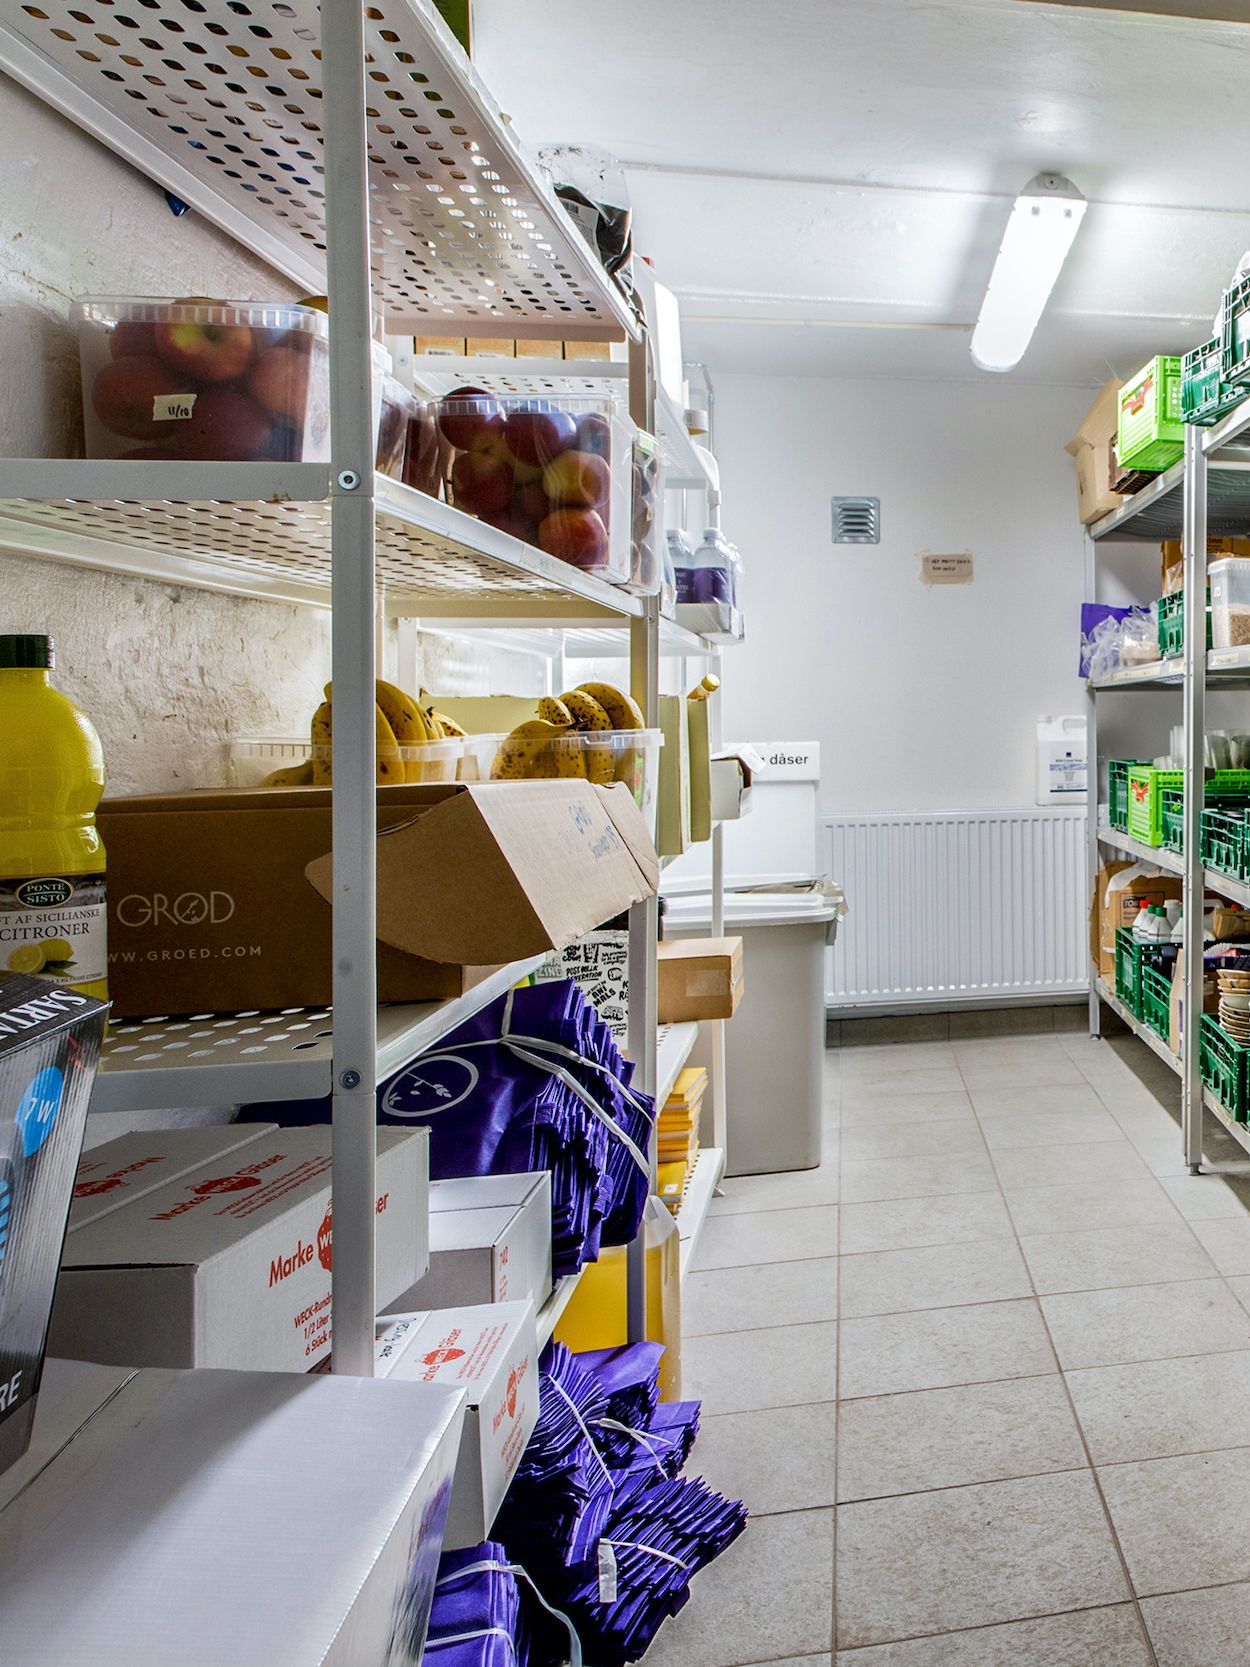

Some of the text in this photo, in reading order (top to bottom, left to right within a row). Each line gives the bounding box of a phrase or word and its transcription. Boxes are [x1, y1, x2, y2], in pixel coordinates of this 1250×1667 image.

[769, 753, 809, 765] dåser
[26, 883, 66, 893] PONTE
[26, 893, 65, 904] SISTO
[15, 915, 32, 924] AF
[36, 908, 100, 923] SICILIANSKE
[0, 922, 90, 941] CITRONER
[269, 1240, 314, 1288] Marke
[303, 1322, 316, 1340] 1/2
[311, 1331, 328, 1352] Stück
